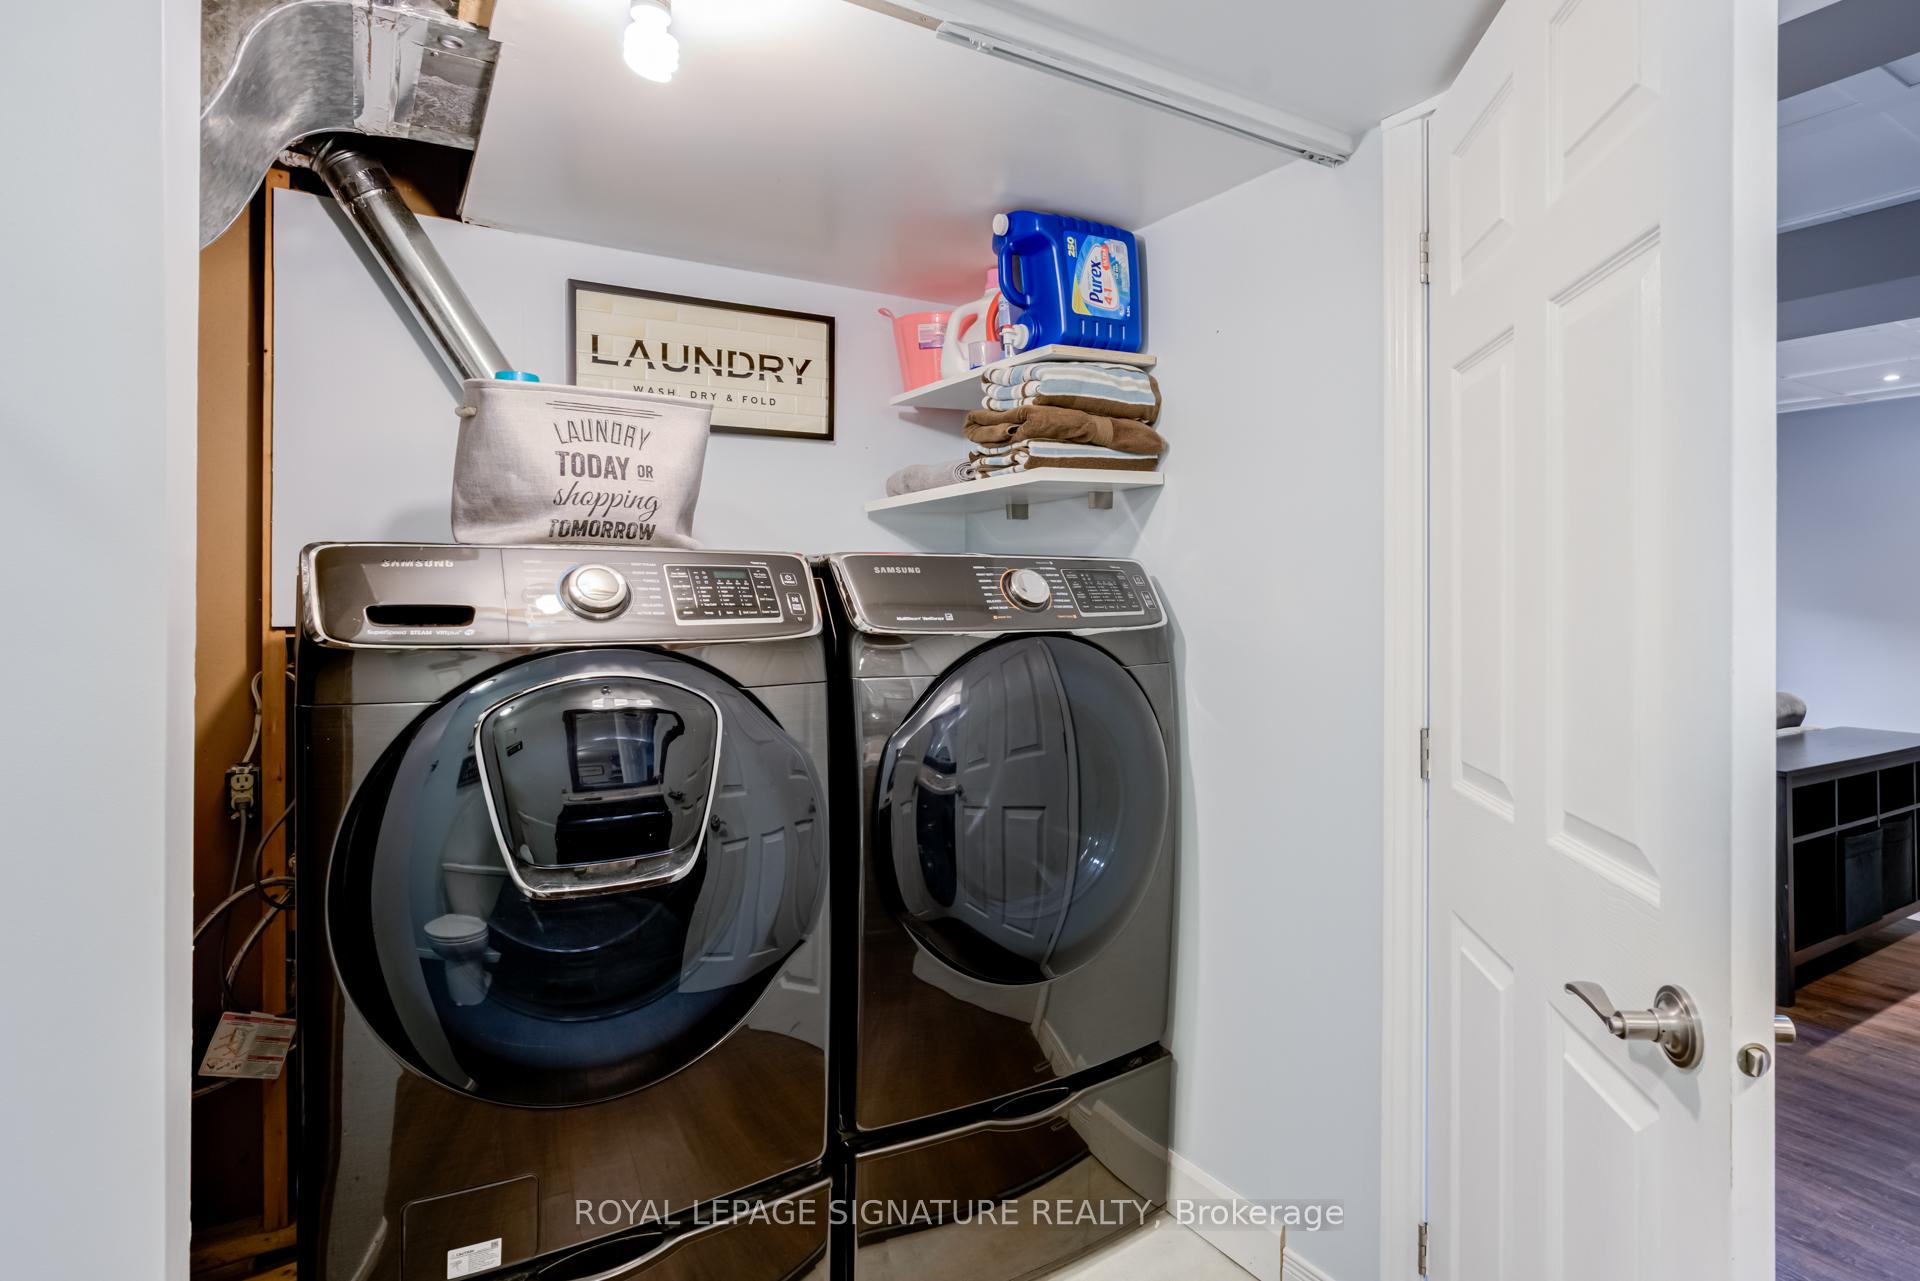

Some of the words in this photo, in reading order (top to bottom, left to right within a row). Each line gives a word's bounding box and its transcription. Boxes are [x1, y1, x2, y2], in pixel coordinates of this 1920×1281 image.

[1089, 260, 1103, 304] Purex
[591, 334, 812, 384] LAUNDRY
[690, 390, 717, 401] DRY
[726, 394, 733, 402] &
[742, 395, 777, 406] FOLD
[552, 417, 652, 451] LAUNDRY
[554, 450, 631, 481] TODAY
[637, 464, 654, 479] OR
[552, 480, 662, 522] shopping
[548, 518, 657, 541] TOMORROW
[381, 558, 455, 568] SAMSUNG
[873, 565, 921, 574] SAMSUNG
